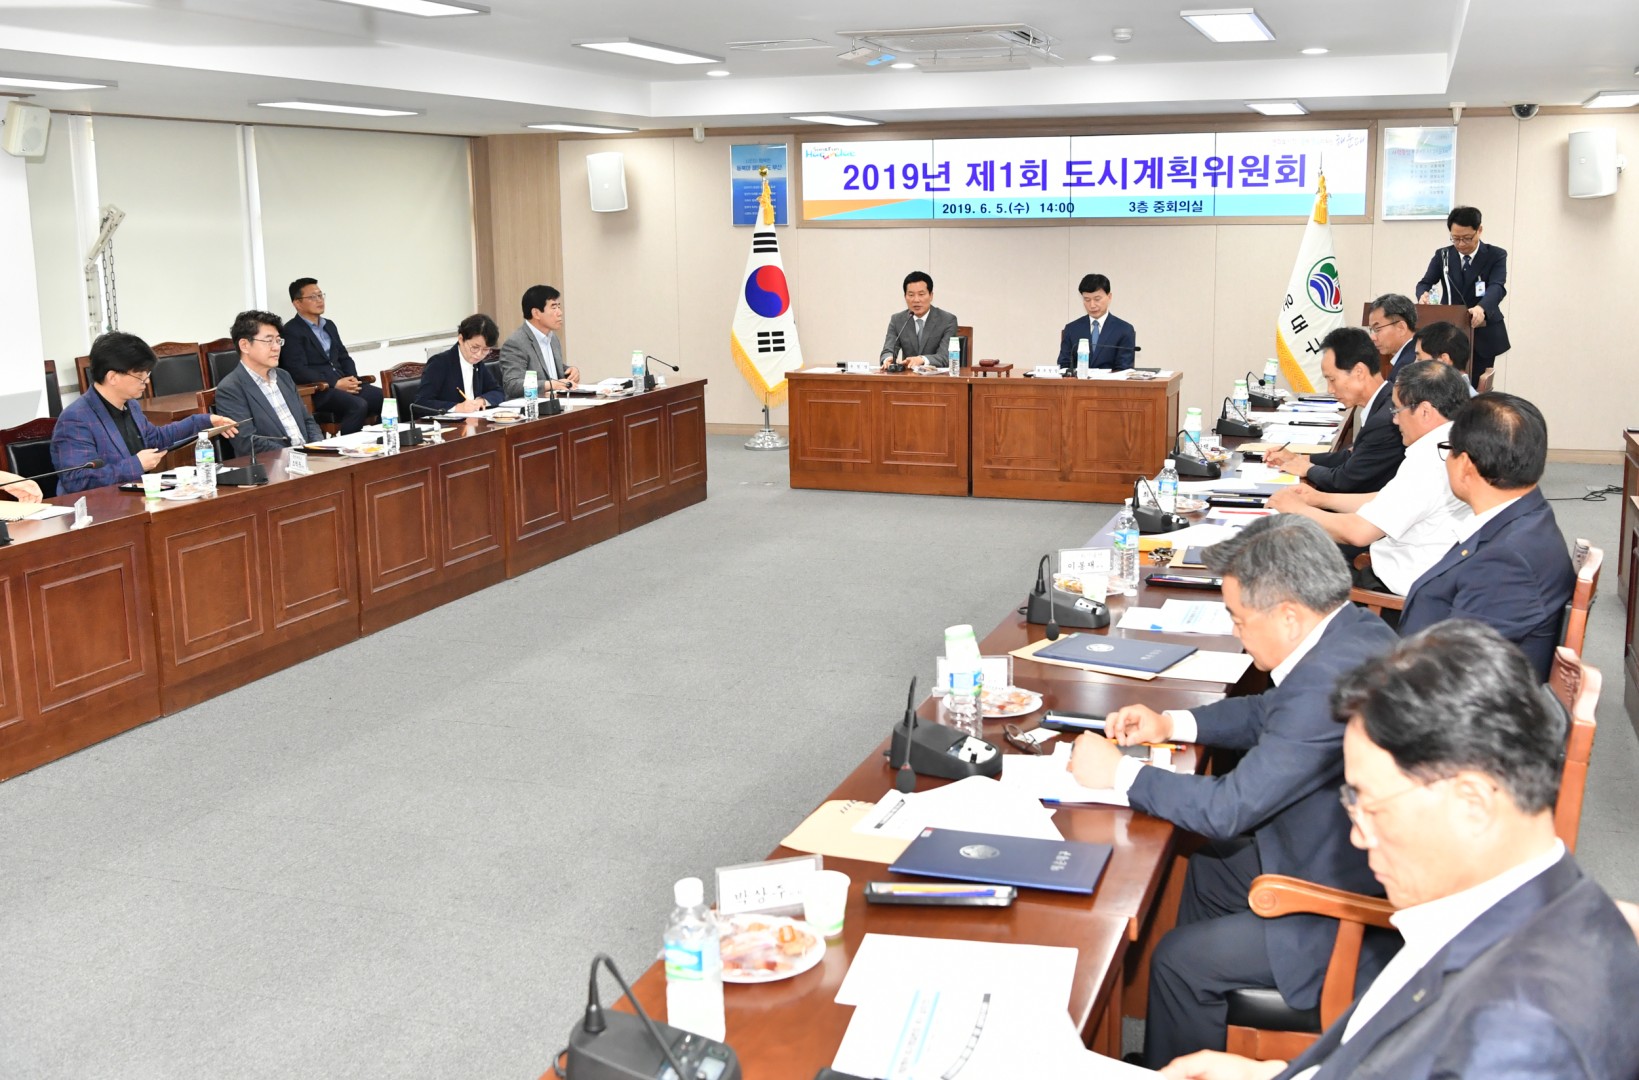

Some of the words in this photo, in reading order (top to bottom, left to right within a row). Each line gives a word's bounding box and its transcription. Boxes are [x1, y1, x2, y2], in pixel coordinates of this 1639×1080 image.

[843, 161, 951, 193] 2019년
[965, 159, 1048, 192] 제1회
[1062, 153, 1307, 191] 도시계획위원회
[942, 203, 976, 214] 2019.
[980, 203, 991, 214] 6.
[996, 202, 1030, 215] 5.(수)
[1039, 202, 1075, 214] 14:00
[1128, 201, 1149, 214] 3층
[1153, 199, 1204, 214] 중회의실
